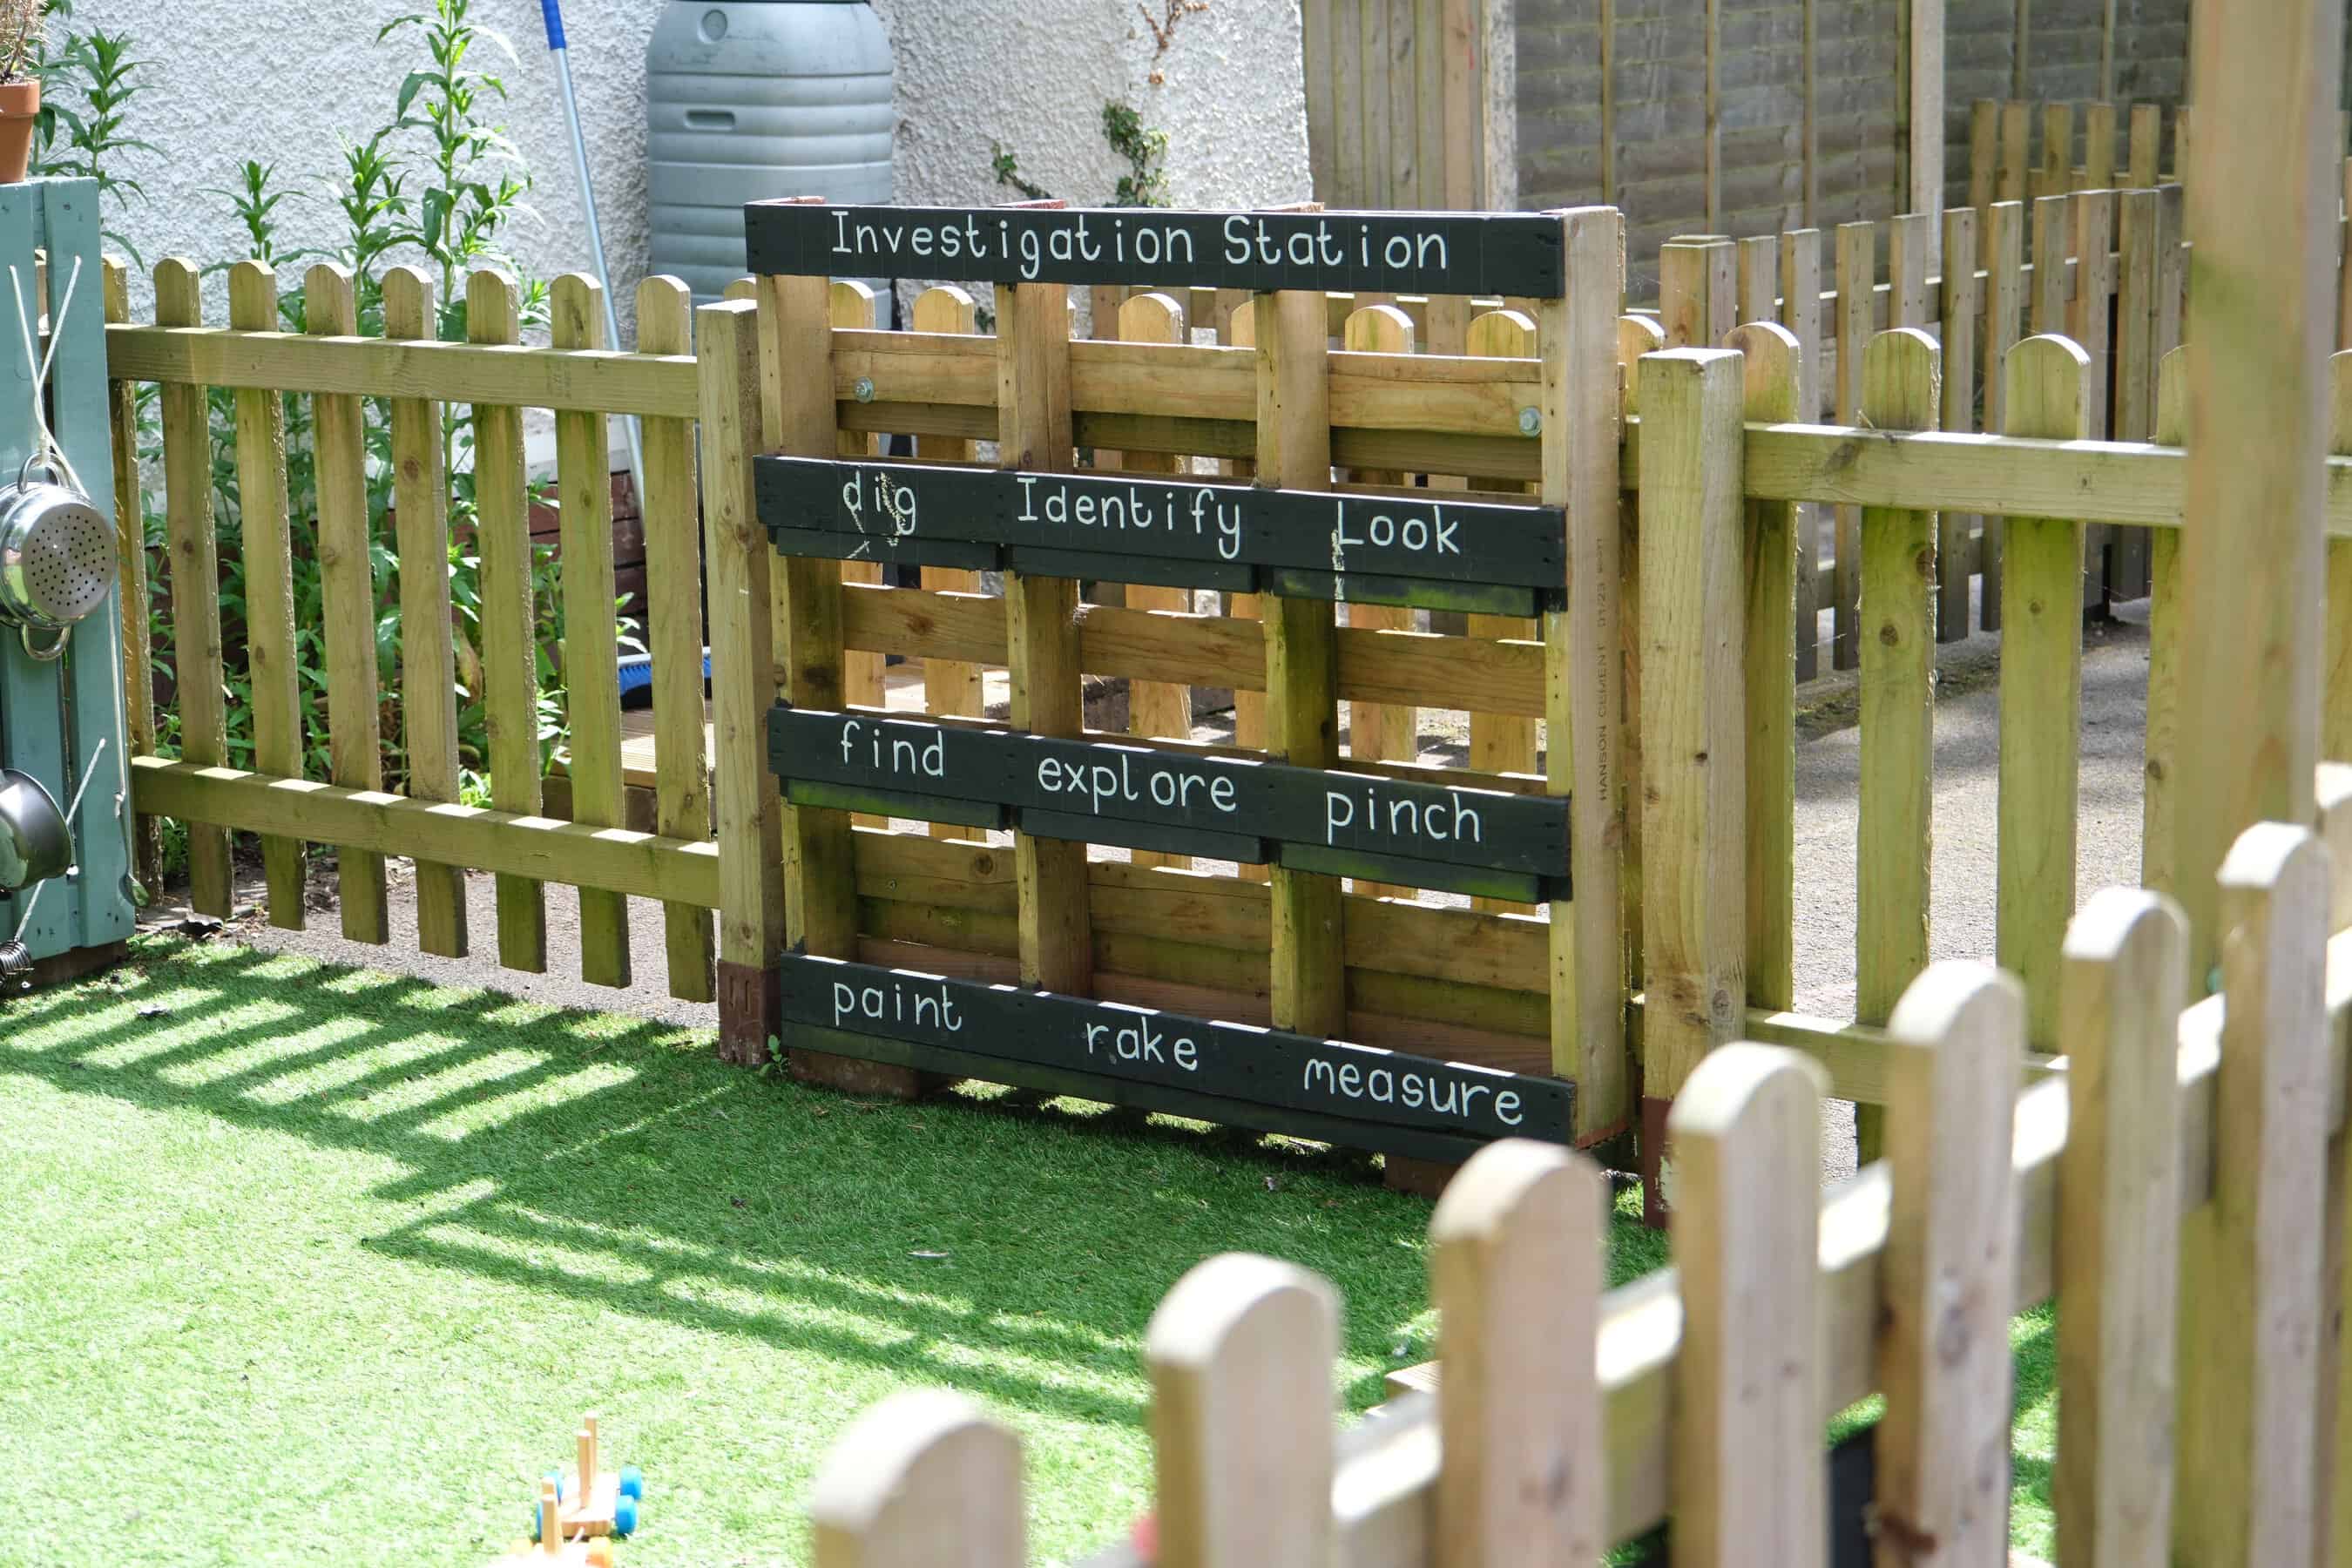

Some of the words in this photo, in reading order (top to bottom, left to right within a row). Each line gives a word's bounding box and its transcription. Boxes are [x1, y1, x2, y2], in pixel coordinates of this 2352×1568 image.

[830, 209, 1194, 280] Investigation
[1223, 214, 1448, 269] Station
[842, 470, 916, 536] dig
[1016, 477, 1241, 559] Identify
[1336, 500, 1461, 555] Look
[841, 720, 944, 777] find
[1038, 755, 1238, 814] explore
[1326, 787, 1481, 844] pinch
[1596, 725, 1608, 801] HANSON
[834, 982, 962, 1031] paint
[1086, 1017, 1198, 1071] rake
[1305, 1059, 1523, 1125] measure
